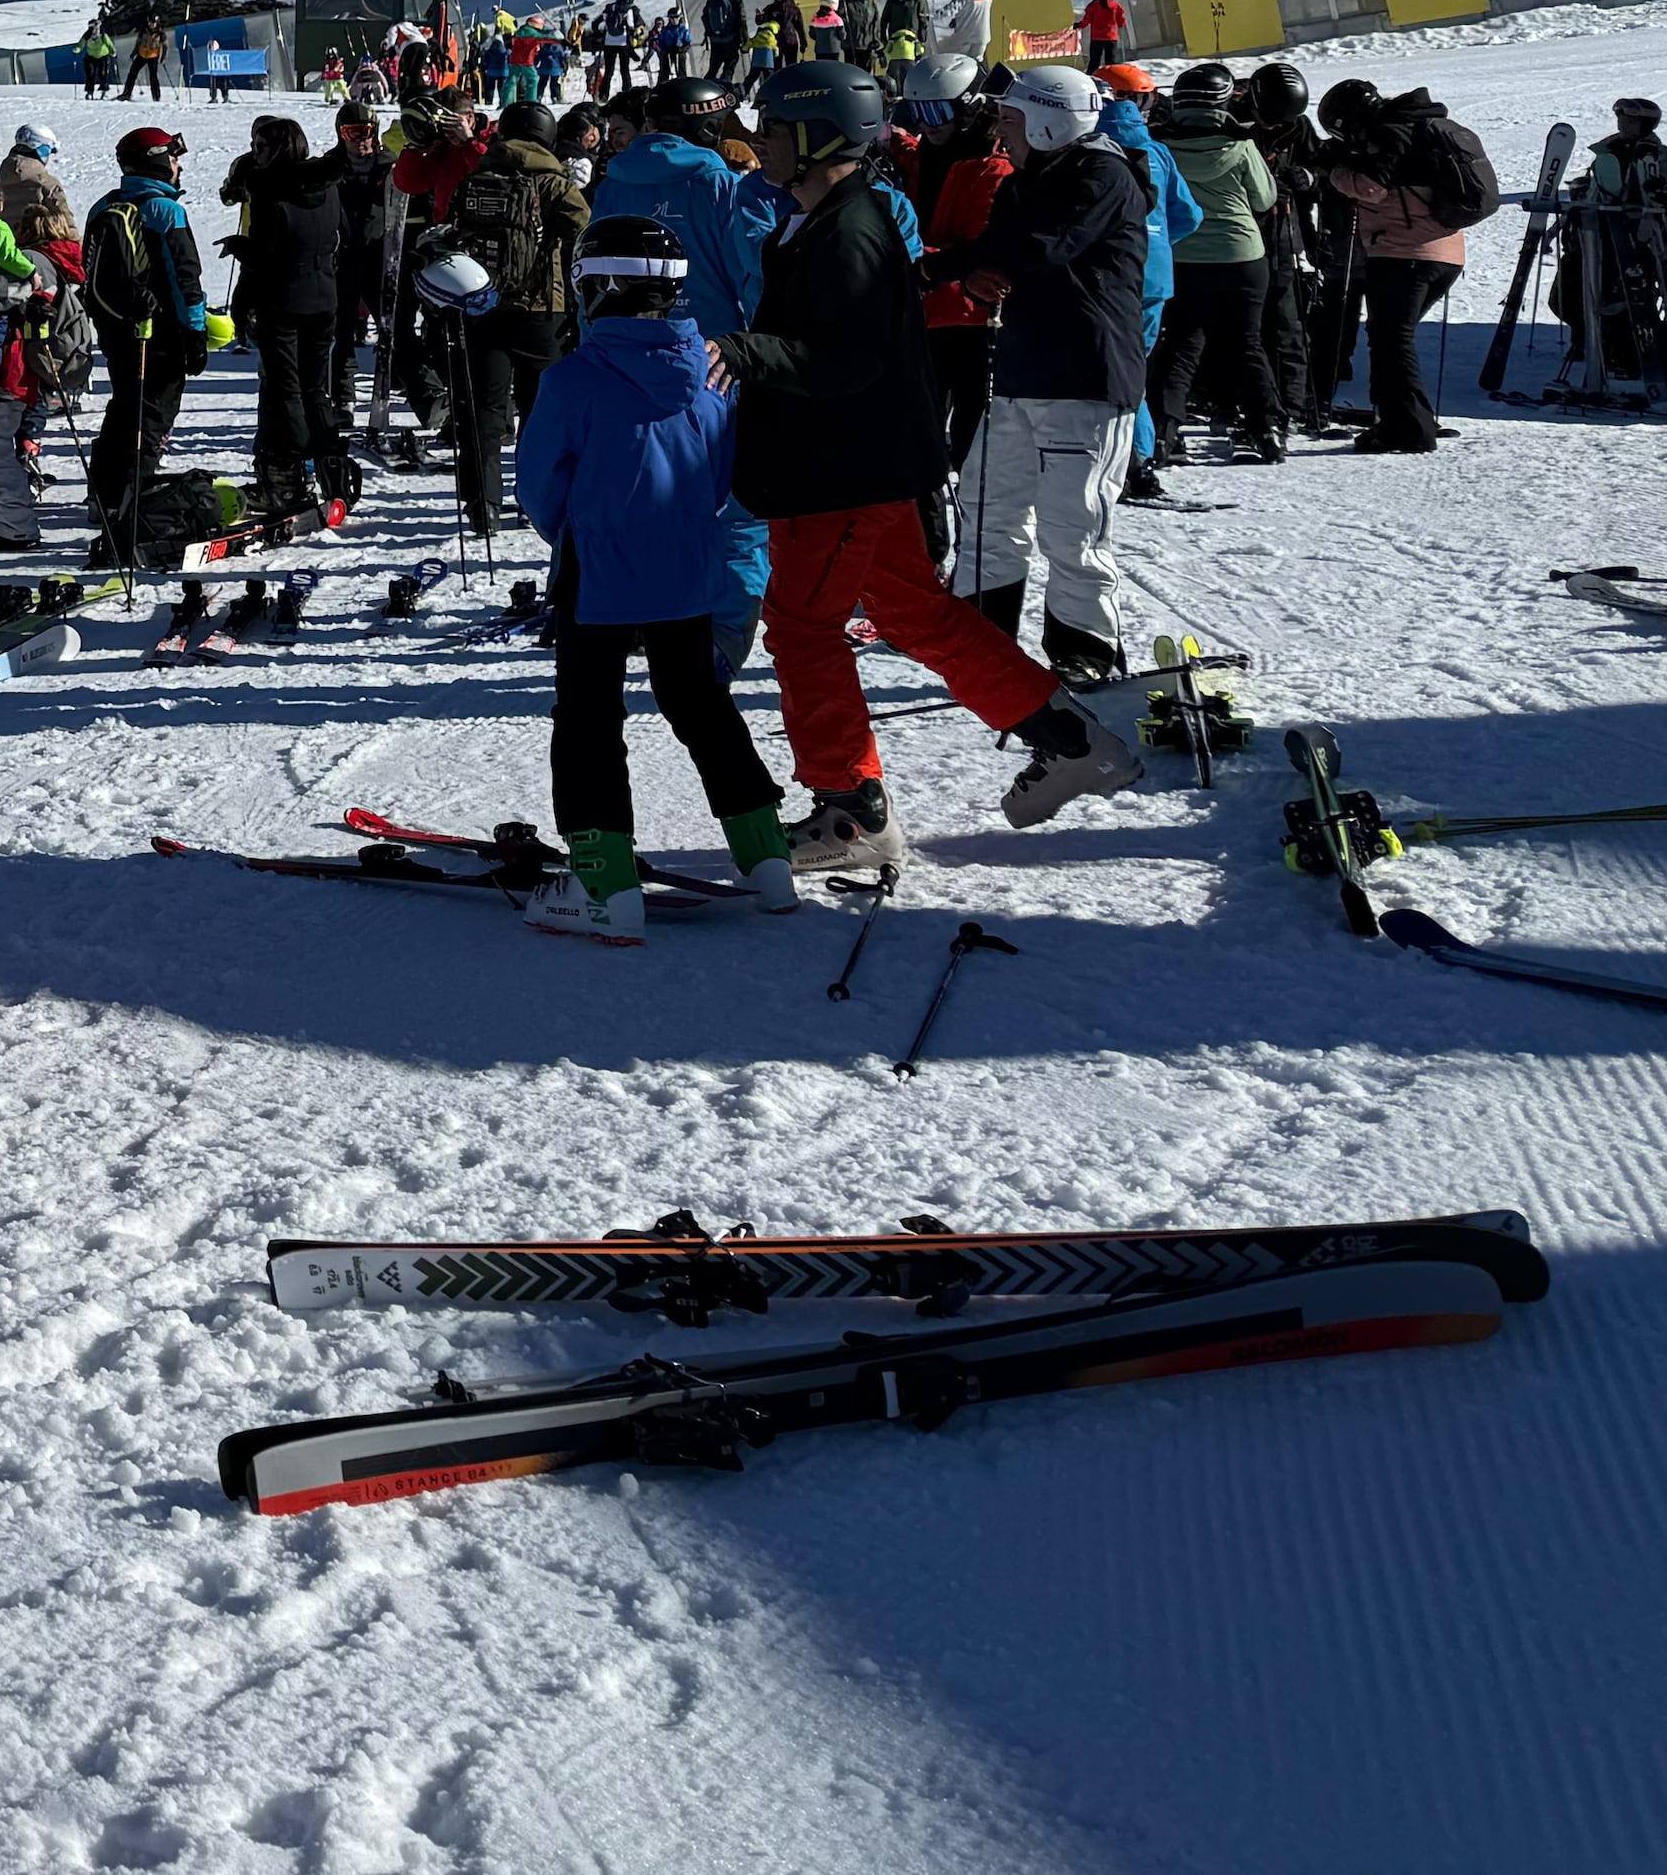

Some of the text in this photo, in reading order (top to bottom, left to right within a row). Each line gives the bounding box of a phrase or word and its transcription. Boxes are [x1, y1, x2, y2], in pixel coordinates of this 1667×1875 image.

[783, 88, 832, 101] SCOTT
[682, 96, 726, 115] ULLER
[1541, 158, 1561, 201] EAD
[394, 1472, 462, 1491] STANCE
